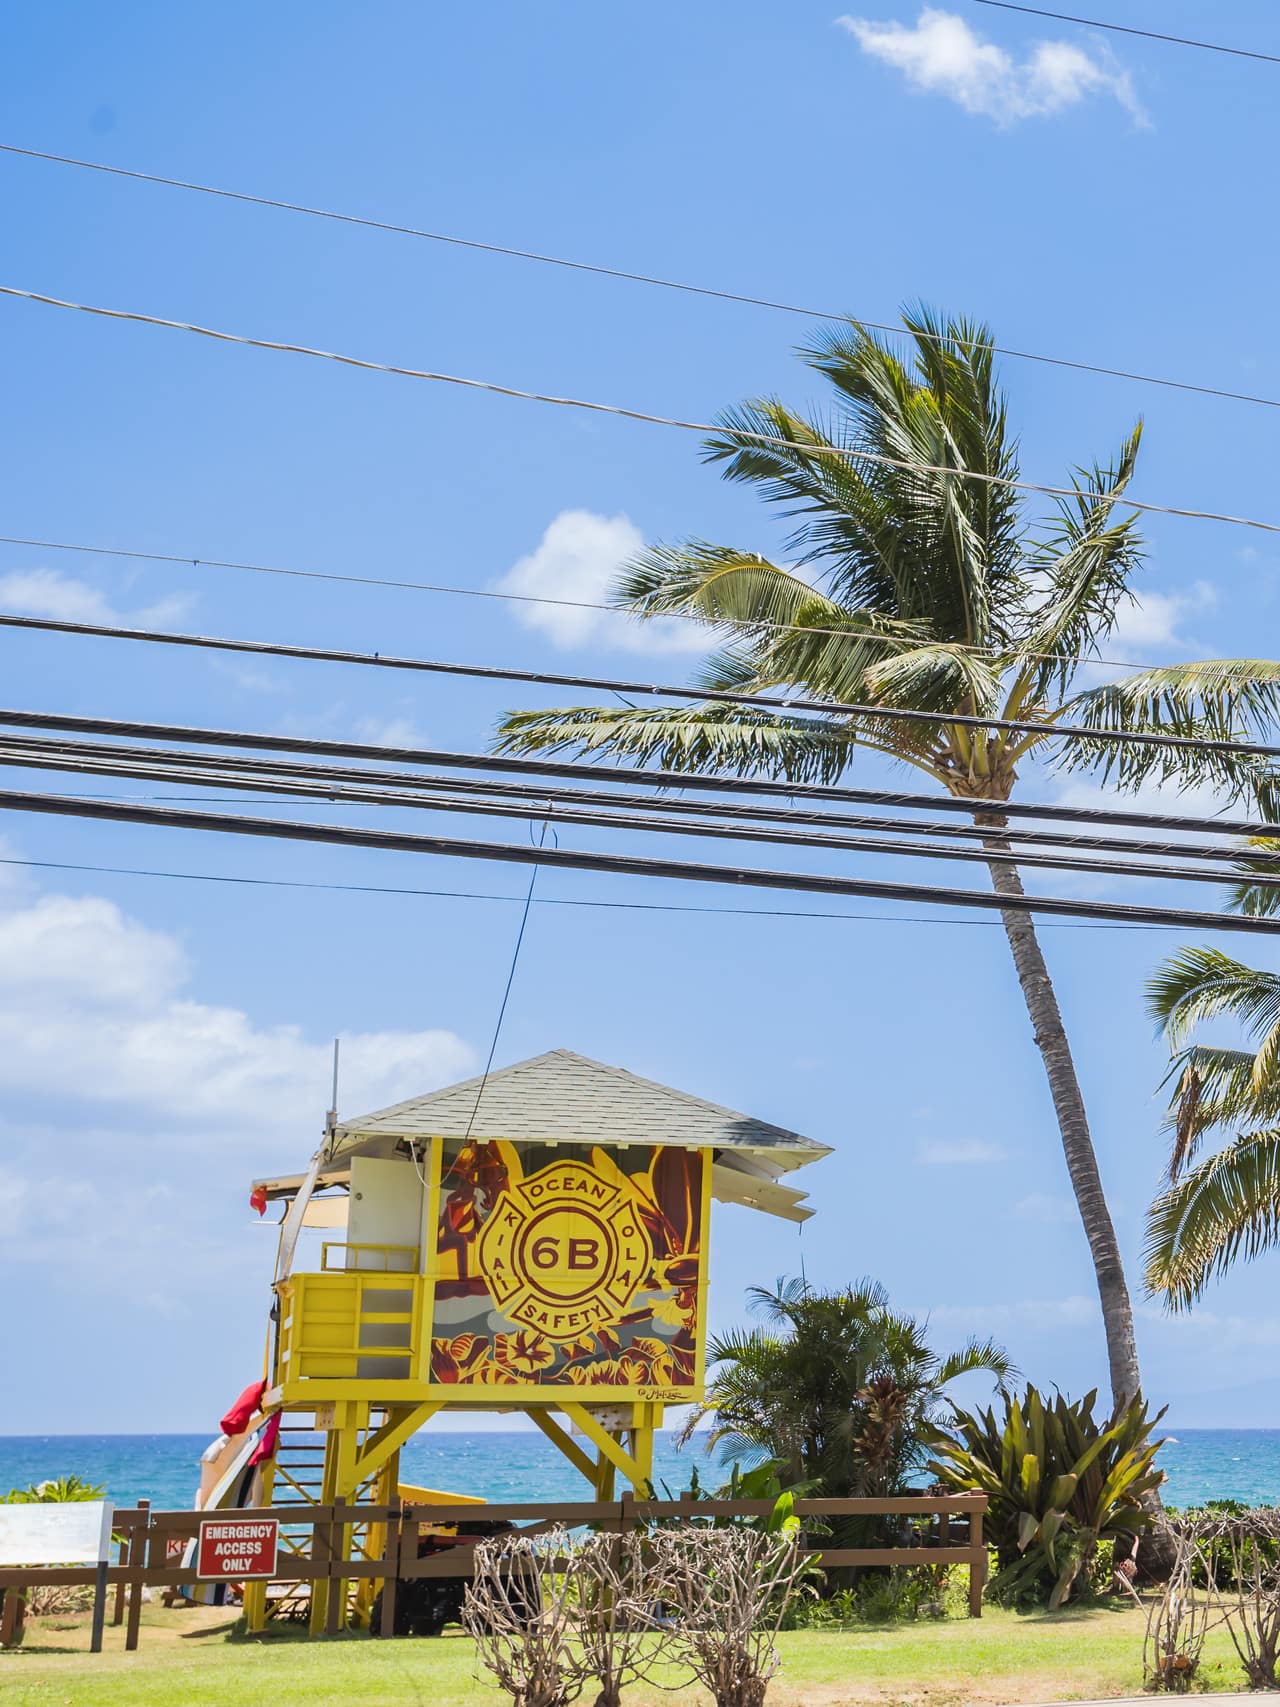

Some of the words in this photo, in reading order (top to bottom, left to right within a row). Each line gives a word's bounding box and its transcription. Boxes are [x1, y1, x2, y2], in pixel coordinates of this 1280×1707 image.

[530, 1177, 606, 1199] OCEAN
[531, 1236, 599, 1270] 6B
[616, 1225, 637, 1287] OLA
[524, 1304, 600, 1329] SAFETY
[205, 1525, 273, 1540] EMERGENCY
[214, 1541, 262, 1556] ACCESS
[222, 1558, 252, 1572] ONLY
